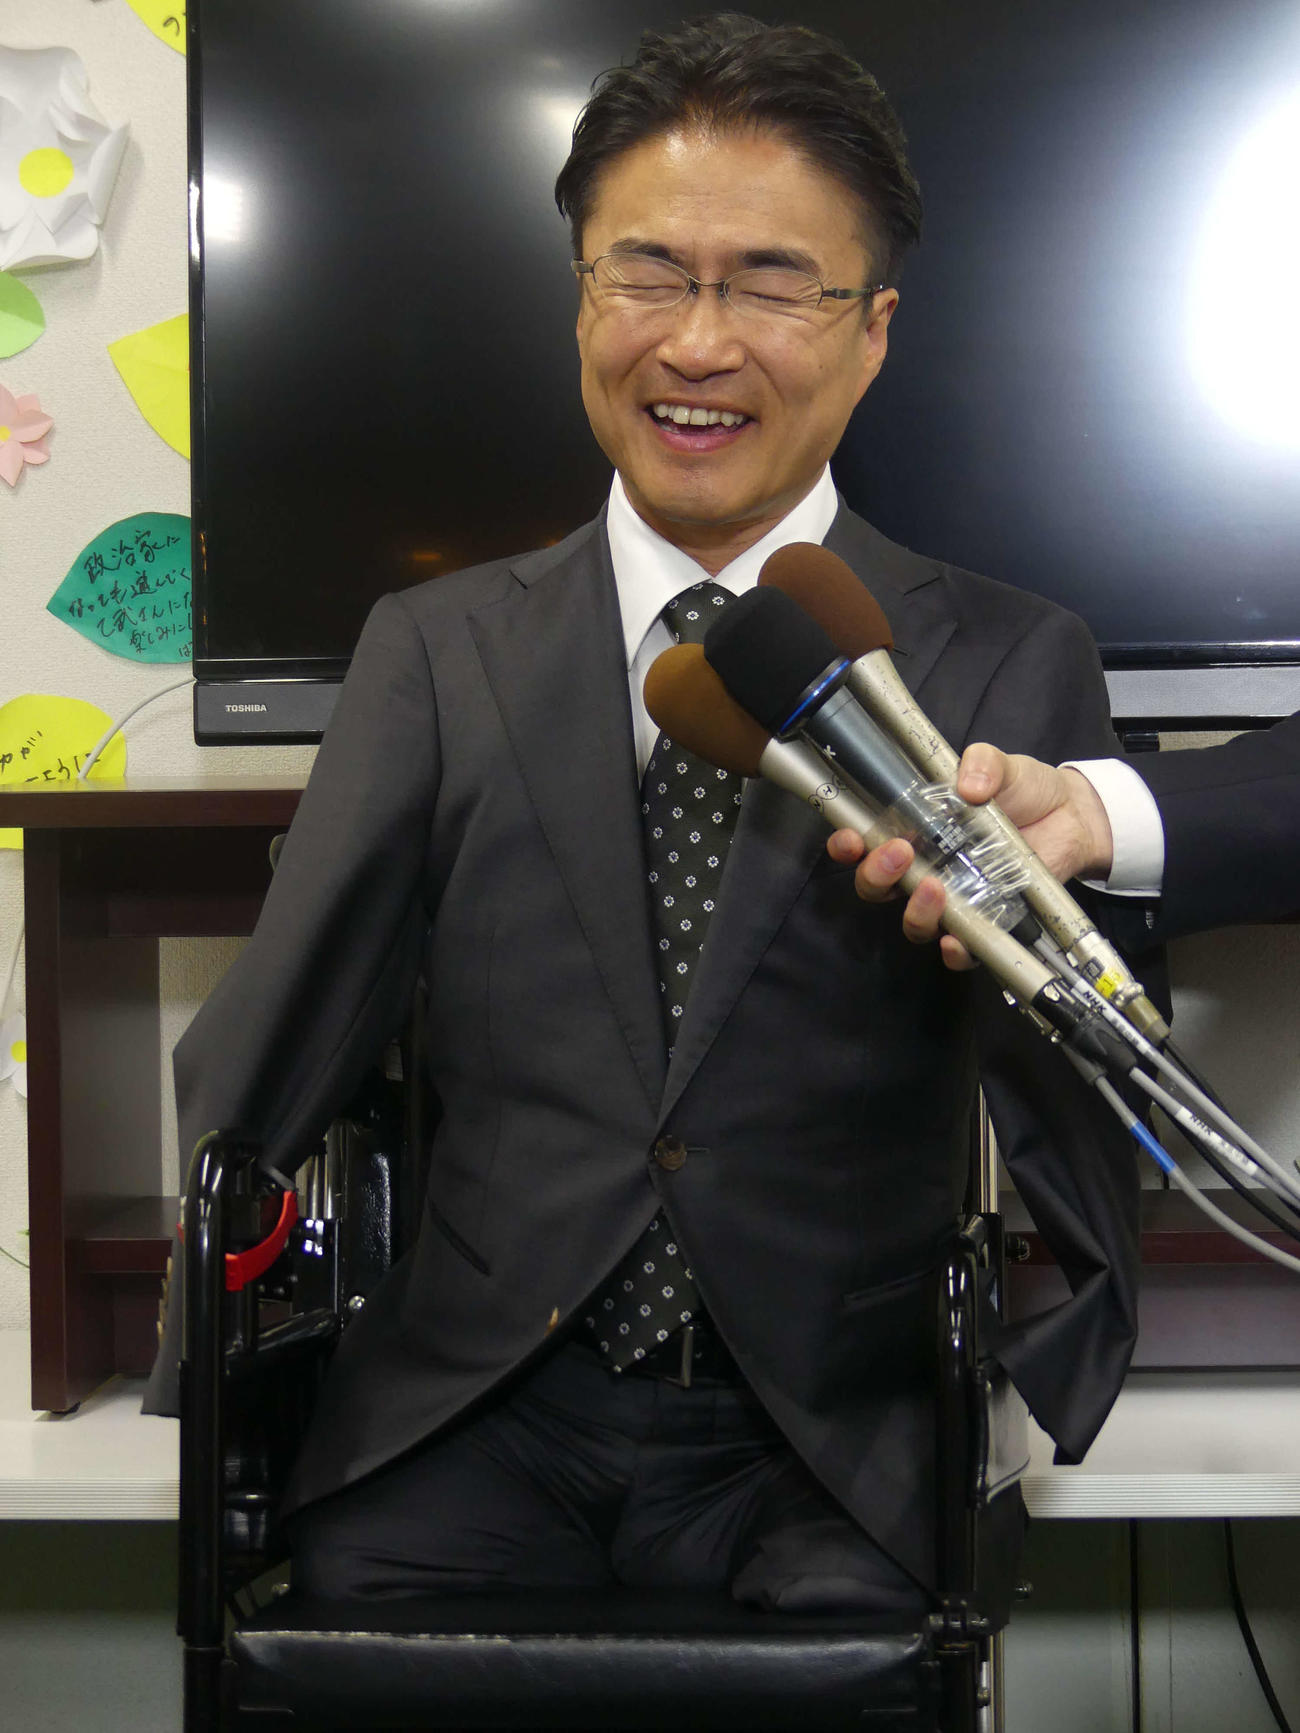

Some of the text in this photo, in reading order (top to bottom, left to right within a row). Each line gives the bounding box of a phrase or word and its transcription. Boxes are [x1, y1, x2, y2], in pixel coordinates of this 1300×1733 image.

[83, 529, 181, 585] 政治家に
[225, 704, 268, 712] TOSHIBA
[1082, 991, 1108, 1016] NHK
